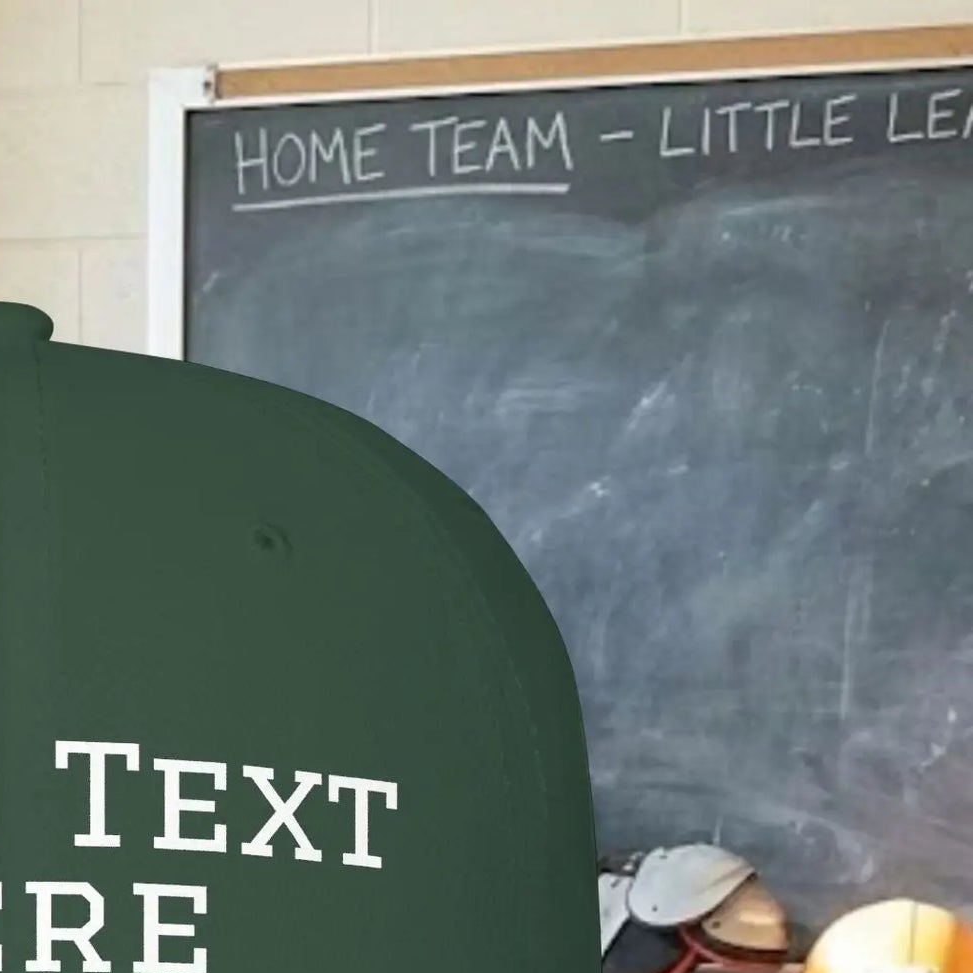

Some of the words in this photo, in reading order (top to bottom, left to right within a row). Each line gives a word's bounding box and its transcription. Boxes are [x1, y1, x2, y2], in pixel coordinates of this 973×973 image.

[234, 124, 387, 195] HOME
[409, 111, 573, 178] TEAM
[660, 94, 857, 157] LITTLE
[55, 740, 397, 868] TEXT
